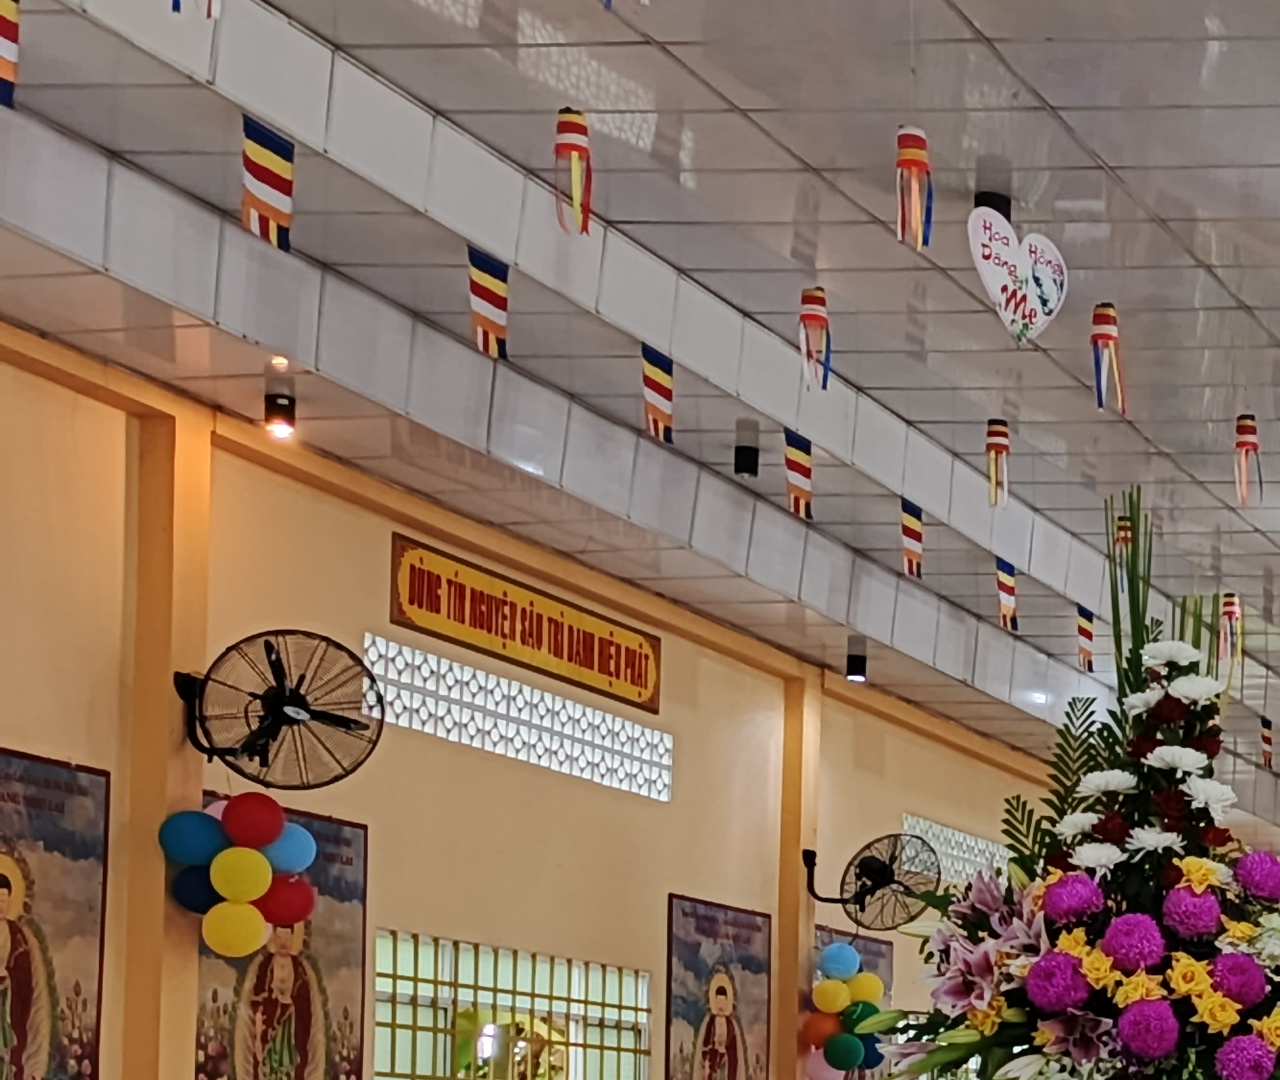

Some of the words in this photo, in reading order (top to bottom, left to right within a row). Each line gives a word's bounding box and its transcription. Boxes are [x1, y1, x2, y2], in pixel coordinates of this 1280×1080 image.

[982, 219, 1009, 247] Hoa
[446, 570, 467, 625] TÍN
[469, 587, 519, 650] NGUYỆN
[519, 600, 545, 651] SÂU
